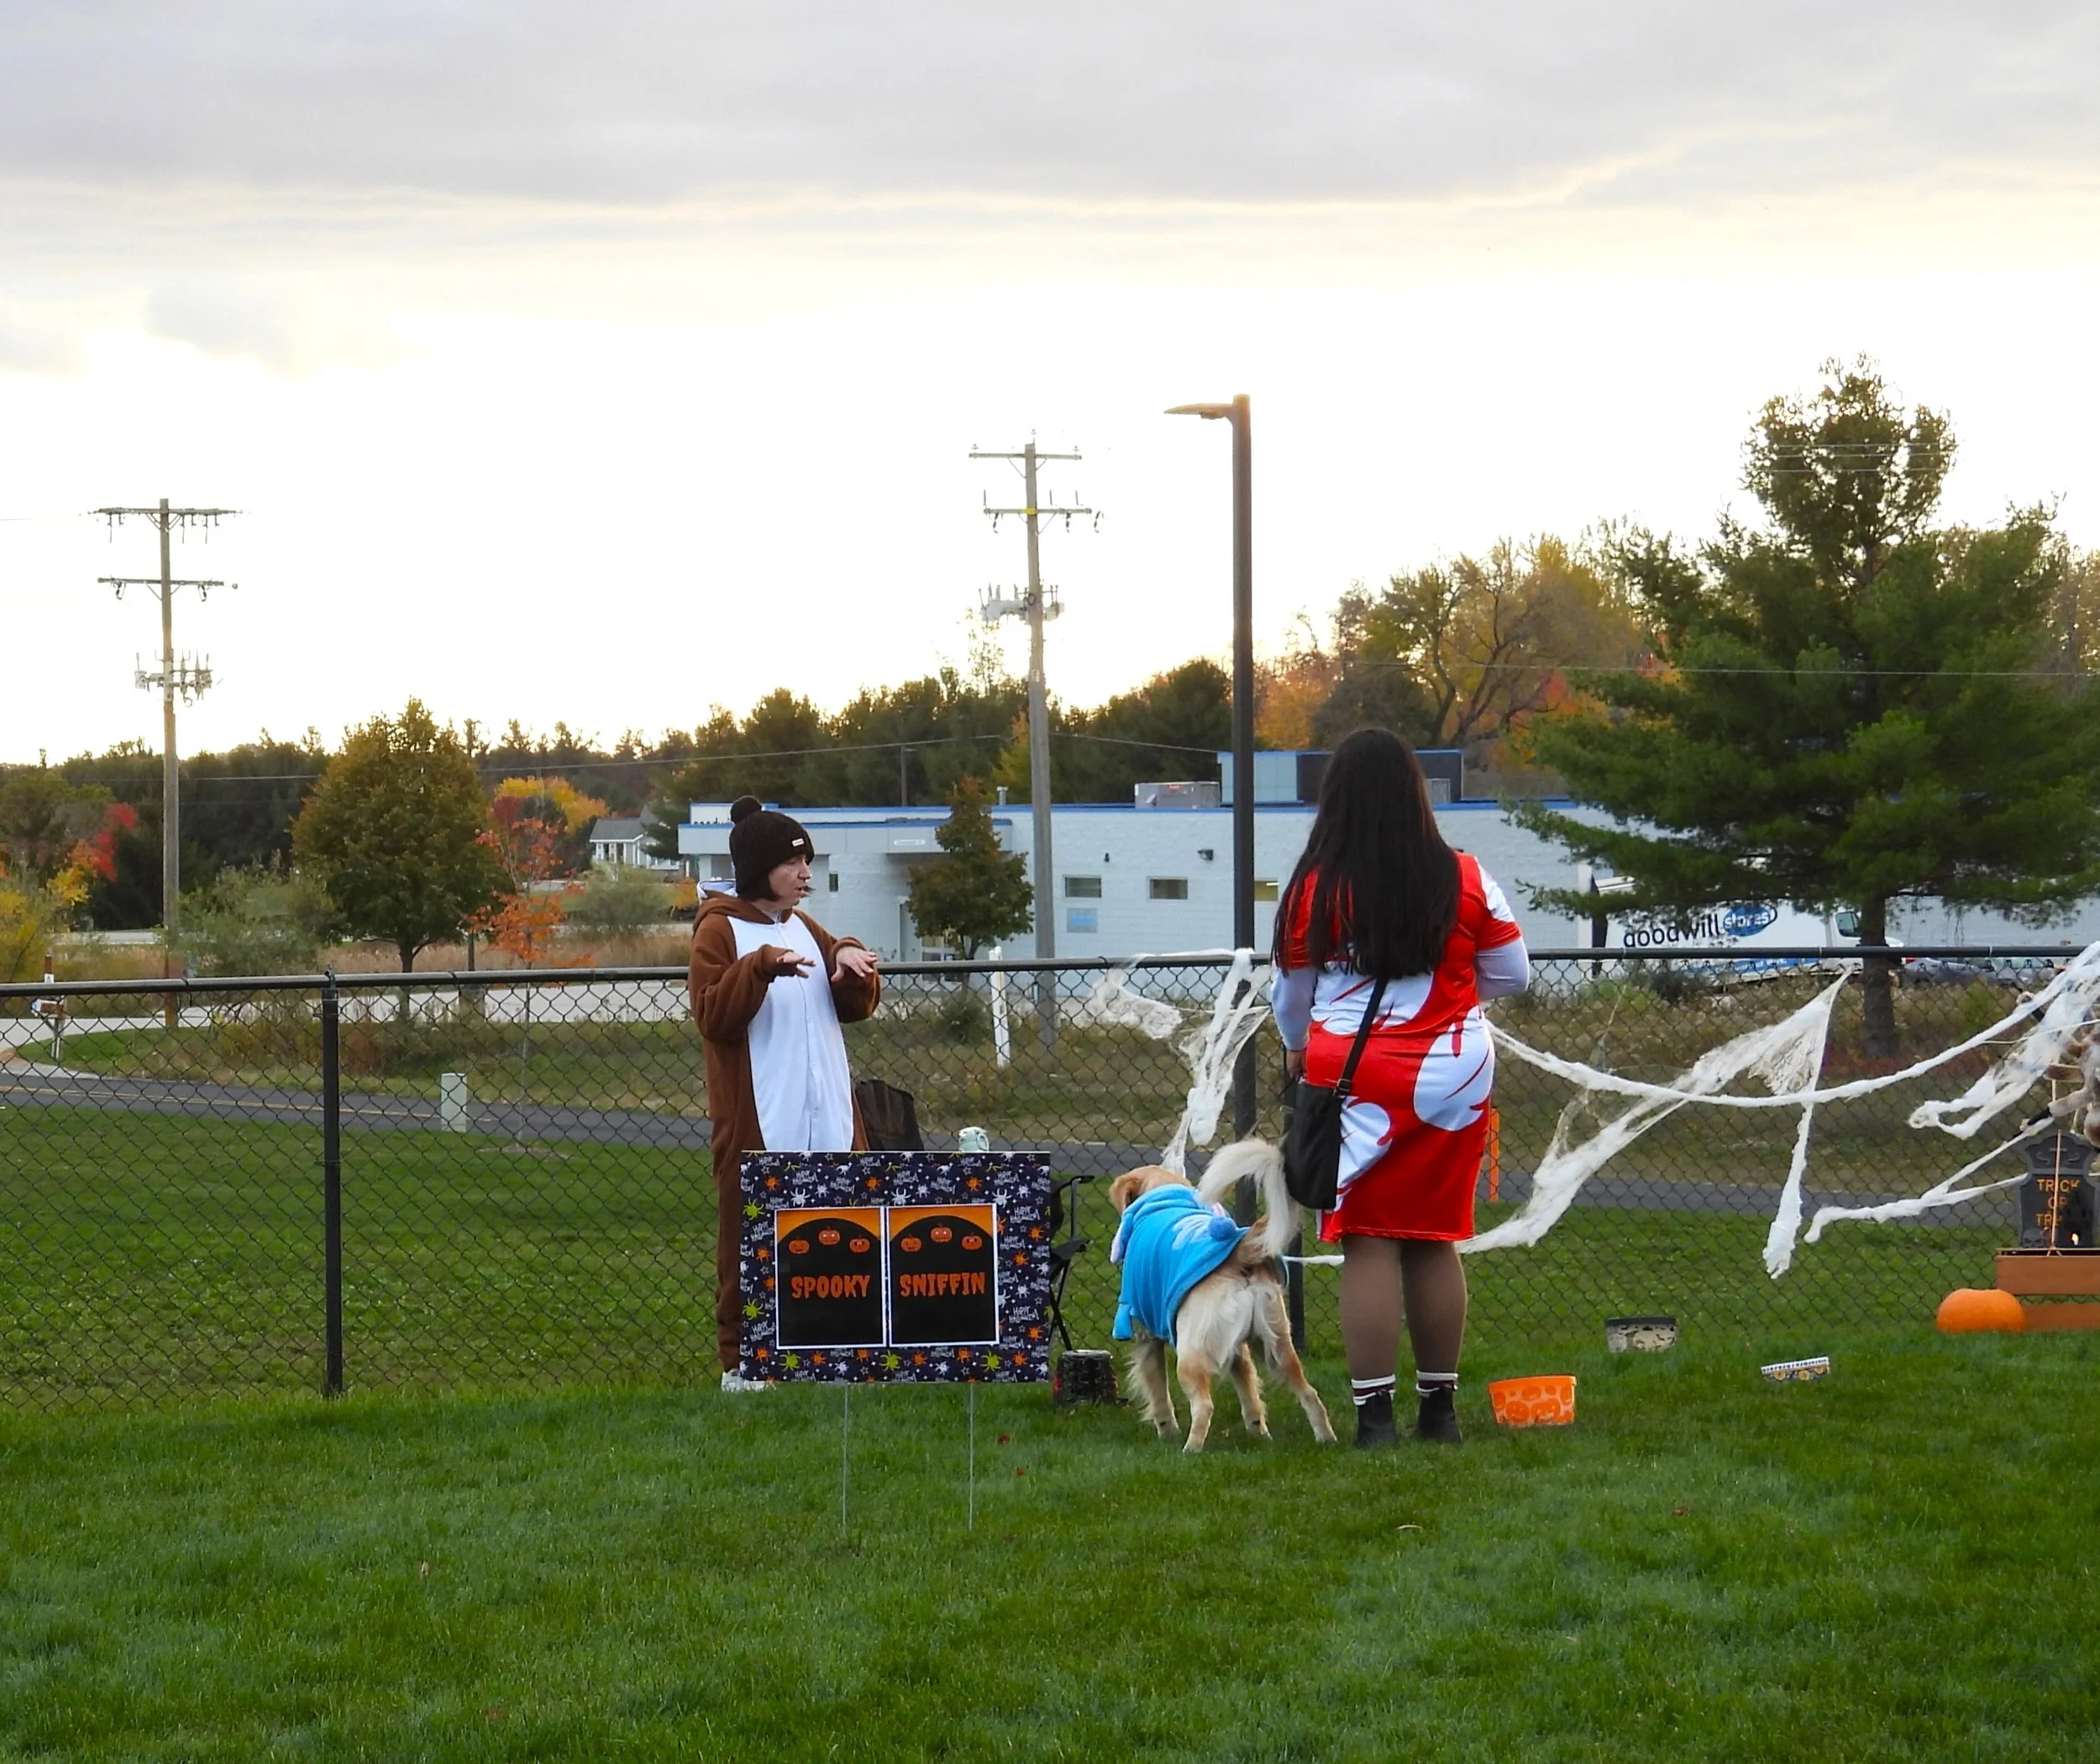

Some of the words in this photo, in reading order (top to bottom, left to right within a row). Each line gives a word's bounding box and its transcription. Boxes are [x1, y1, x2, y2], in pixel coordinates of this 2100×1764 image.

[1624, 914, 1720, 948] goodwill
[1724, 912, 1768, 930] stores
[2036, 1179, 2080, 1192] TRCK
[791, 1275, 870, 1299] SPOOKY
[900, 1272, 985, 1297] SNIFFIN
